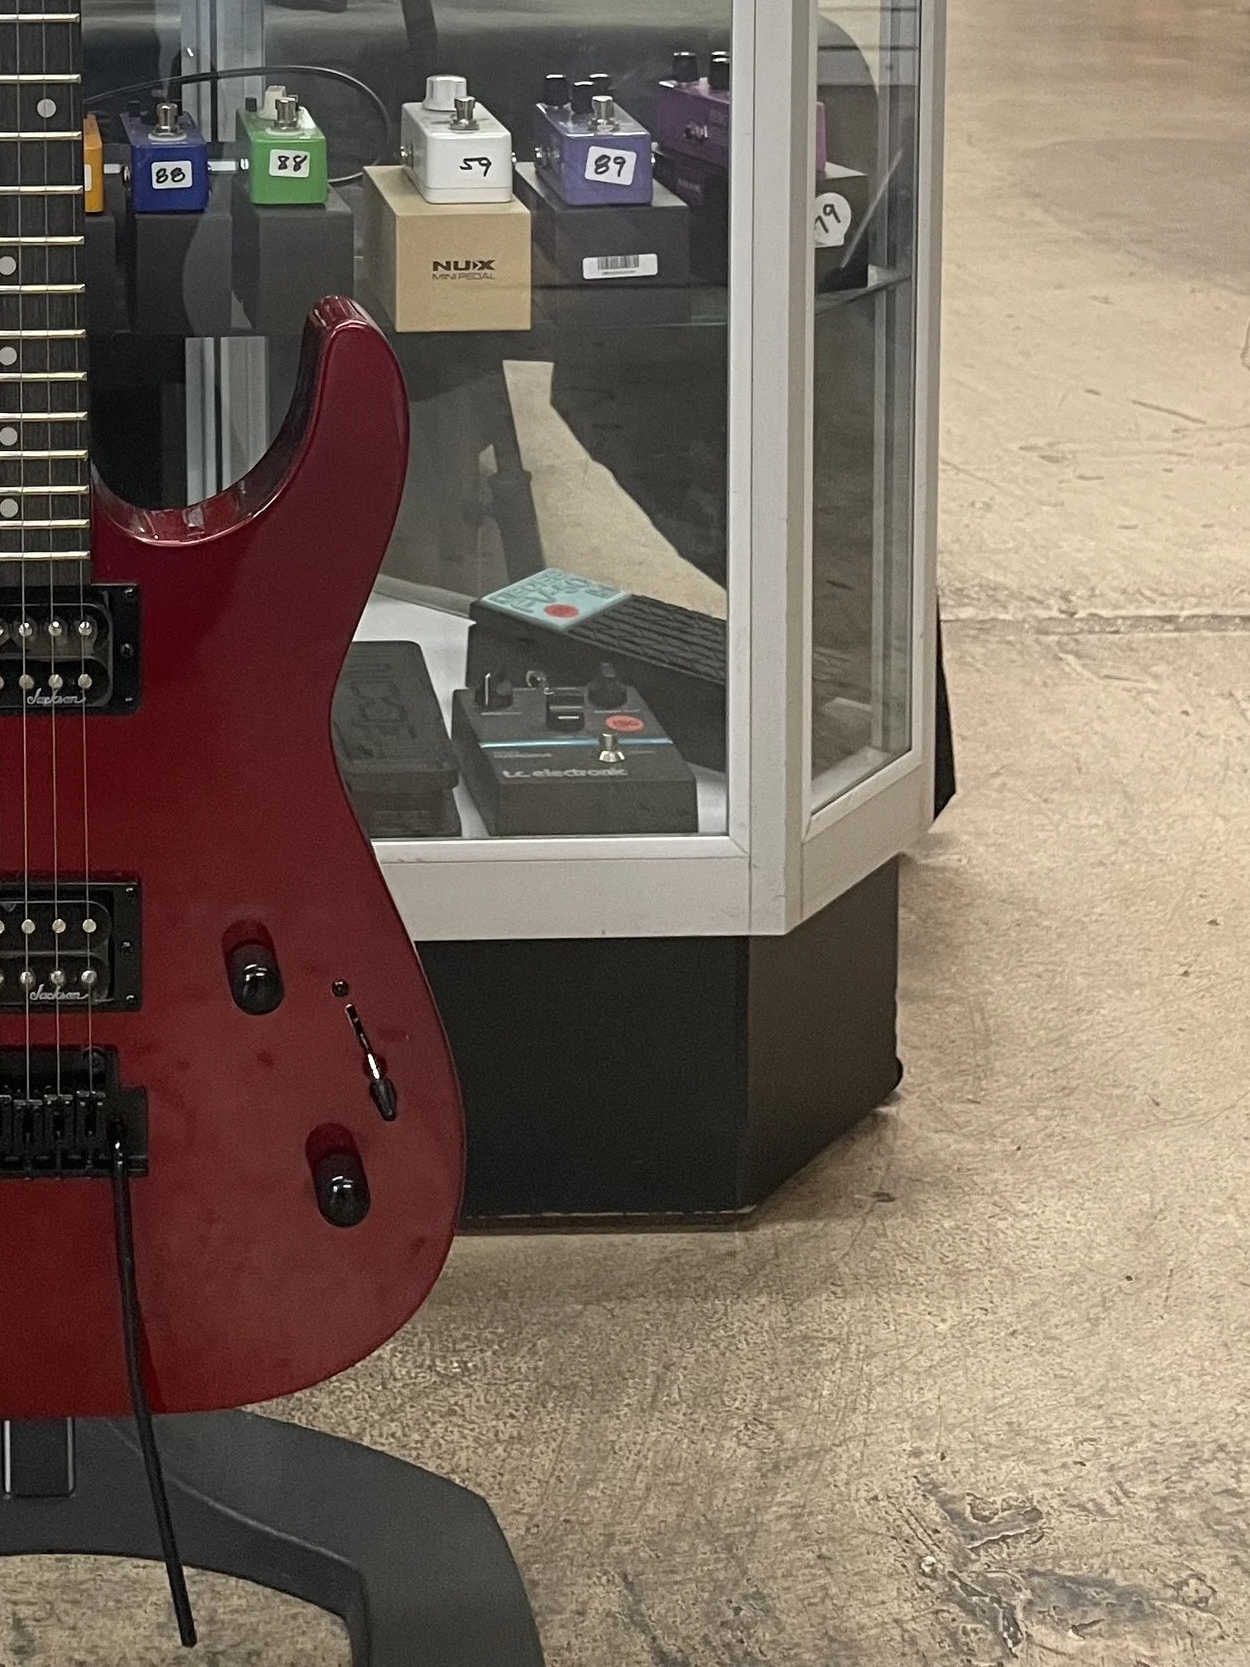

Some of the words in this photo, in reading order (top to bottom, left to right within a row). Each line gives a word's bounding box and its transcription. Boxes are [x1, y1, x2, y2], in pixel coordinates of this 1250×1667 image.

[277, 155, 308, 172] 88
[459, 157, 492, 177] 59
[594, 154, 626, 177] 89
[155, 167, 185, 184] 88
[432, 259, 496, 271] NUX
[432, 272, 457, 281] MINI
[457, 272, 496, 281] PEDAL
[26, 687, 87, 705] Jackson
[532, 767, 628, 778] electronic
[29, 983, 90, 1001] Jackson
